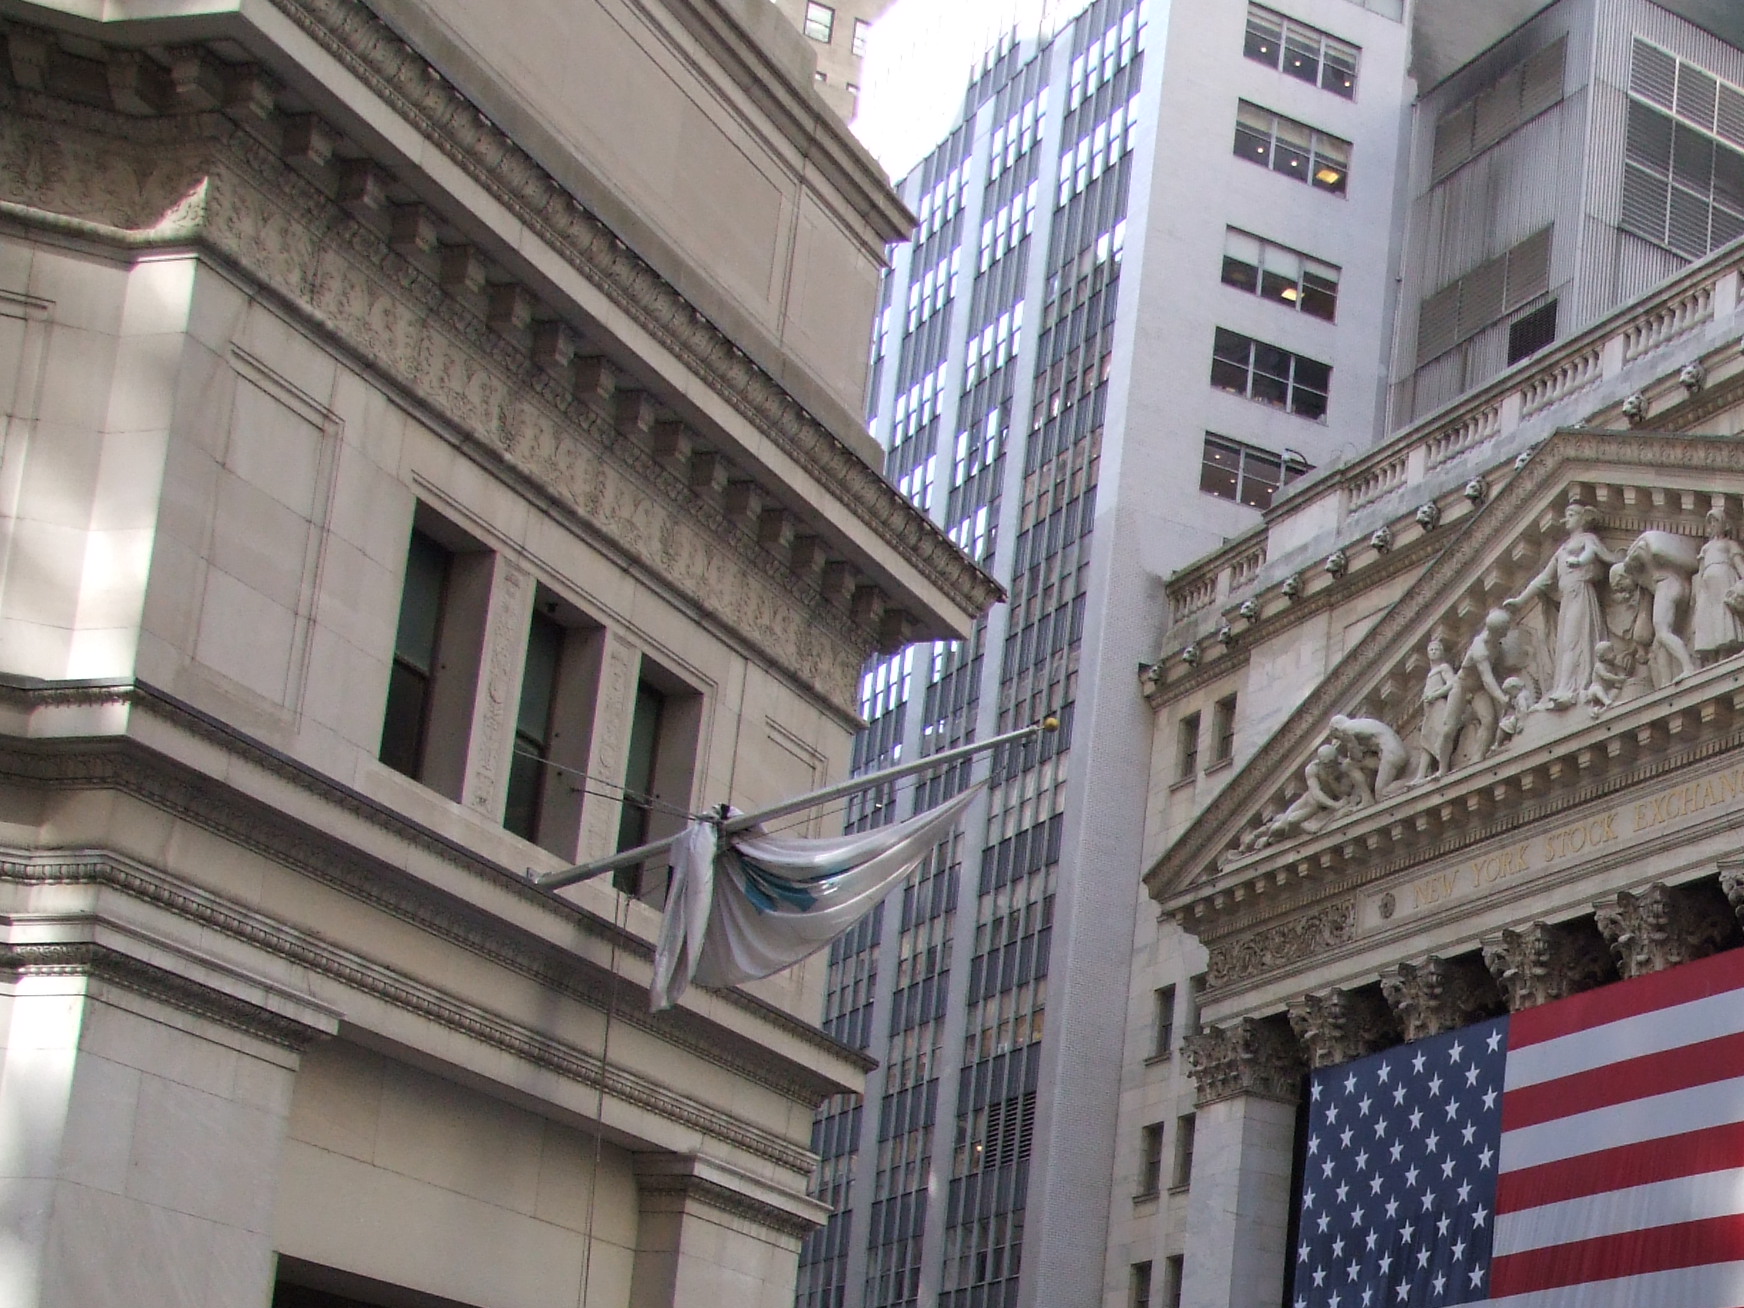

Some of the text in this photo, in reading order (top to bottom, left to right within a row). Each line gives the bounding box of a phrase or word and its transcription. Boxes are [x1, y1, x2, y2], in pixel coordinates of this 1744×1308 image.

[1413, 869, 1460, 909] NEW
[1472, 843, 1530, 888] YORK
[1545, 812, 1619, 862] STOCK
